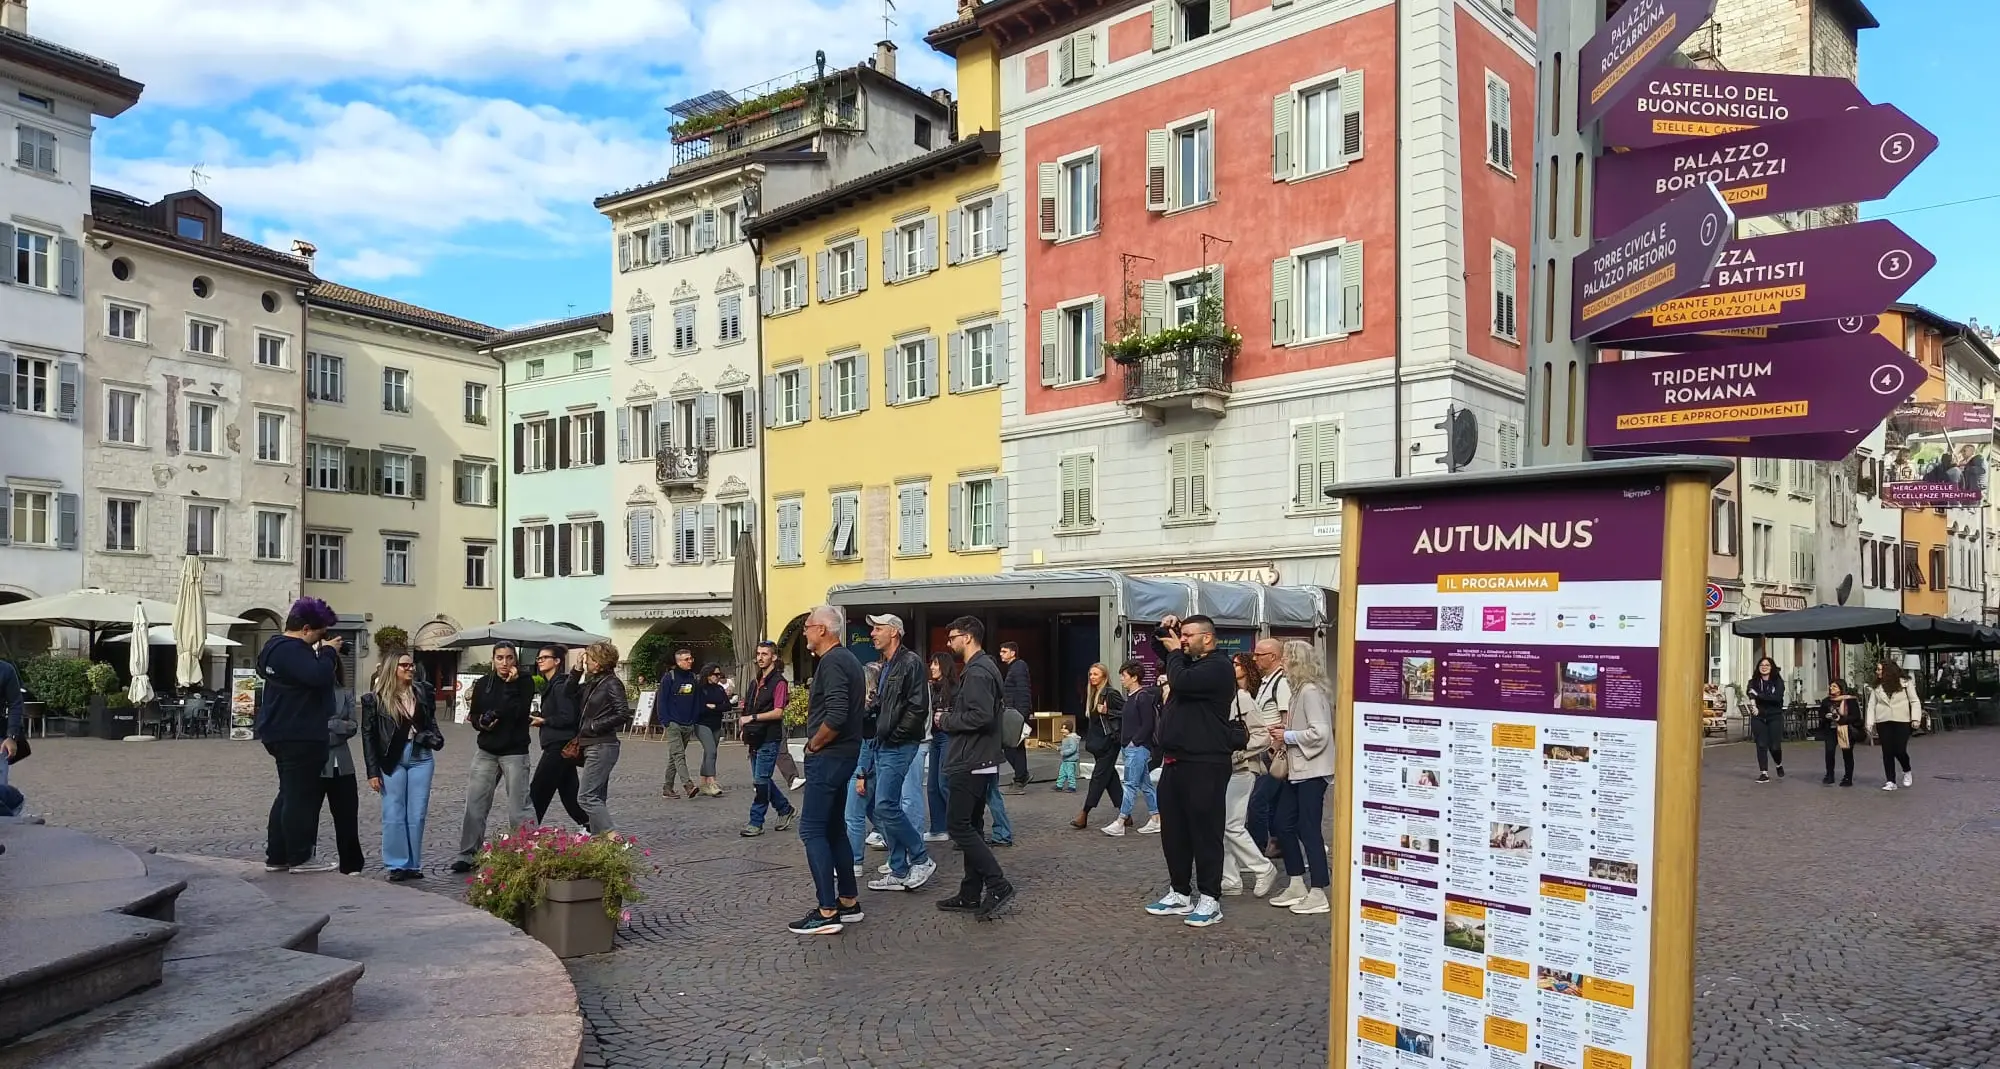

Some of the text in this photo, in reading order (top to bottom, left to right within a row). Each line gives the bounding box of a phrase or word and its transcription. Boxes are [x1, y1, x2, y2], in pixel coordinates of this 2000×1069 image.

[1611, 0, 1653, 44] PALAZZO
[1601, 3, 1664, 73] ROCCABRUNA
[1592, 58, 1632, 100] DEGUSTAZIONI
[1649, 81, 1778, 102] CASTELLO DEL
[1637, 98, 1789, 120] BUONCONSIGLIO
[1656, 122, 1693, 133] STELLE
[1698, 125, 1710, 134] AL
[1674, 141, 1902, 171] PALAZZO 5
[1655, 158, 1786, 193] BORTOLAZZI
[1722, 187, 1765, 201] ZIONI
[1593, 247, 1622, 275] TORRE
[1625, 229, 1657, 258] CIVICA
[1660, 222, 1667, 240] E
[1714, 248, 1900, 271] ZZA 3
[1584, 239, 1677, 299] PALAZZO PRETORIO
[1719, 261, 1804, 286] BATTISTI
[1583, 291, 1622, 317] DEGUSTAZIONI
[1630, 281, 1647, 296] VISITE
[1648, 266, 1674, 287] GUIDATE
[1713, 296, 1725, 306] DI
[1730, 287, 1801, 304] AUTUMNUS
[1656, 303, 1776, 324] CASA CORAZZOLLA
[1652, 359, 1892, 386] TRIDENTUM 4
[1665, 382, 1756, 404] ROMANA
[1620, 404, 1805, 426] MOSTRE E APPROFONDIMENTI
[1446, 577, 1549, 589] IL PROGRAMMA
